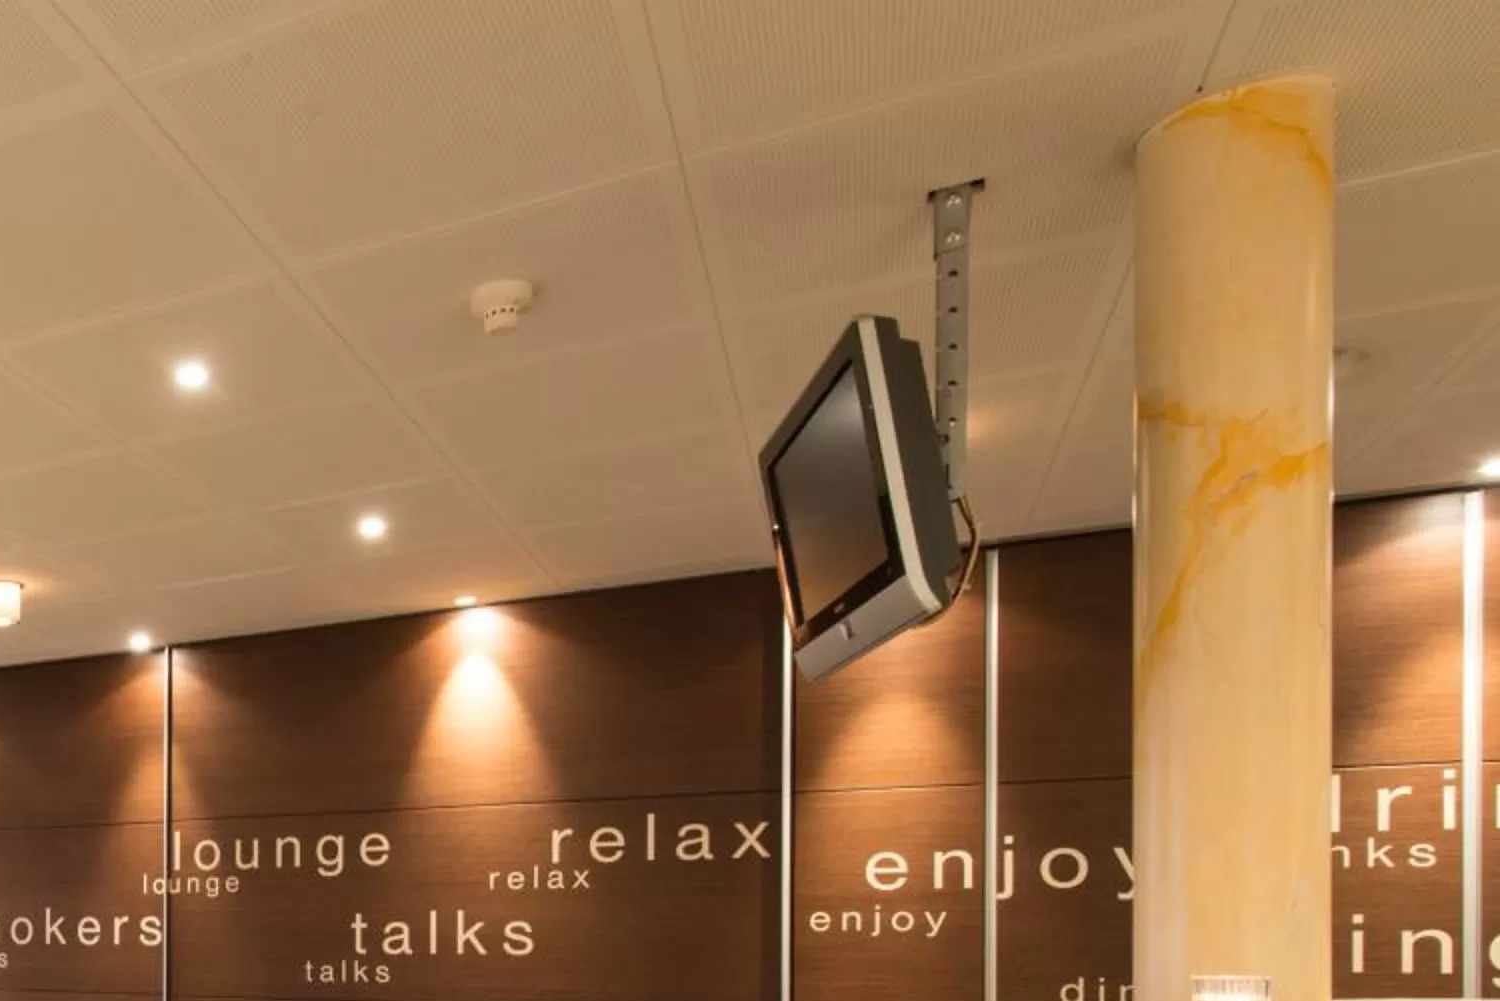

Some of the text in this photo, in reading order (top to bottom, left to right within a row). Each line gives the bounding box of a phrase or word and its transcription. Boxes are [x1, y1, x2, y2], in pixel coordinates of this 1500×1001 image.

[172, 830, 390, 877] lounge
[551, 813, 770, 863] relax
[143, 874, 240, 897] lounge
[489, 865, 590, 890] relax
[864, 835, 1134, 900] enjoy
[351, 910, 534, 955] talks
[809, 905, 947, 937] enjoy
[305, 960, 391, 983] talks
